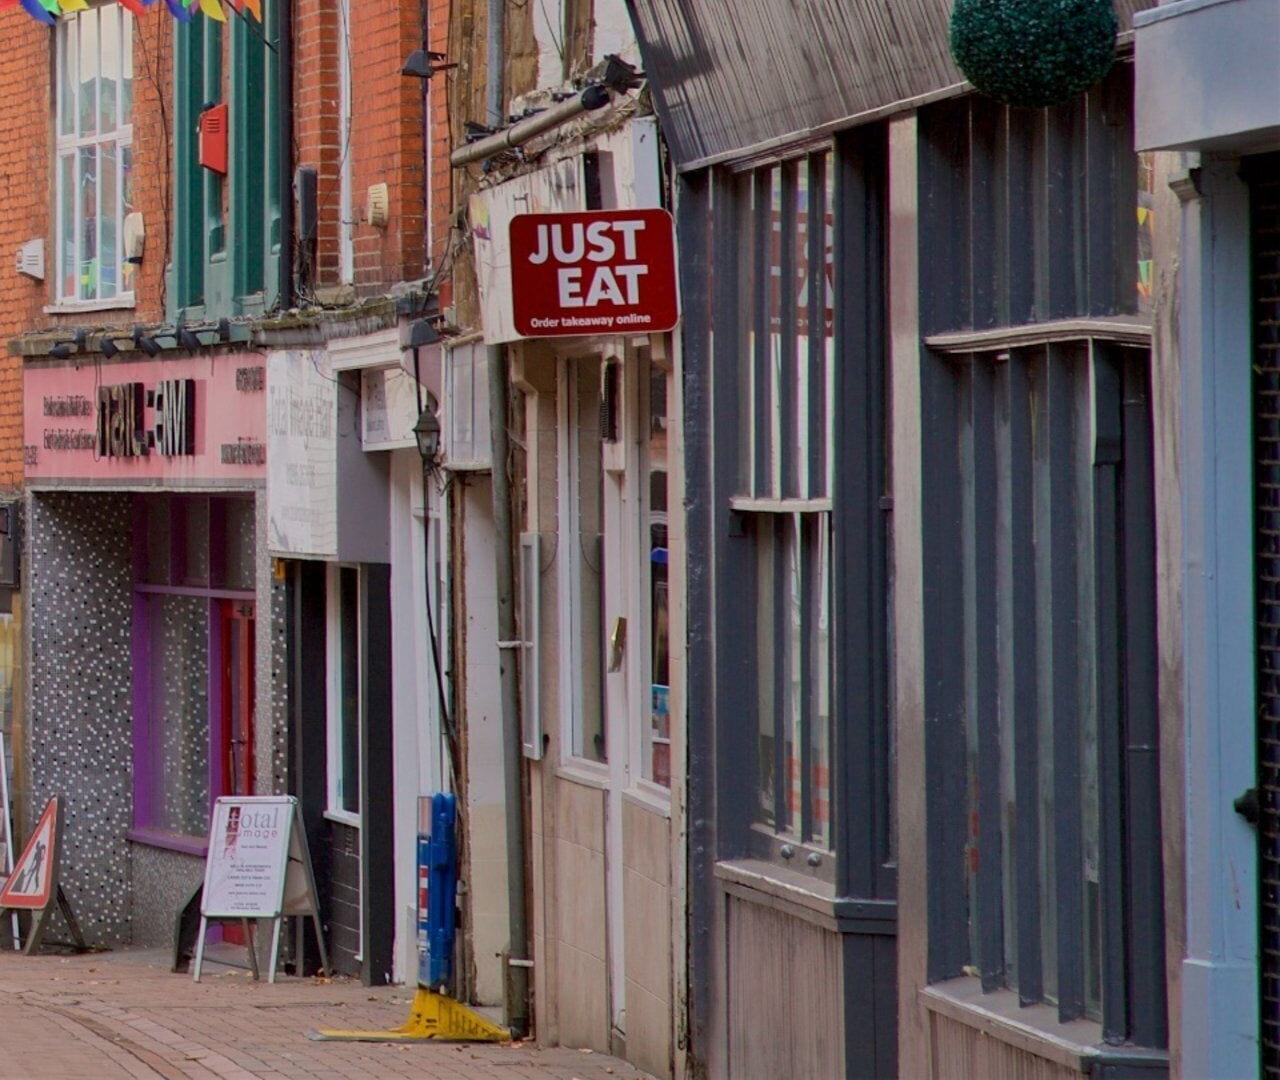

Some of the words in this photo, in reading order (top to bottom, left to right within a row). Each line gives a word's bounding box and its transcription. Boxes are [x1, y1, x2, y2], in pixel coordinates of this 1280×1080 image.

[528, 220, 646, 264] JUST
[557, 264, 649, 308] EAT
[530, 317, 559, 328] Order
[561, 315, 614, 328] takeaway
[616, 313, 651, 324] online
